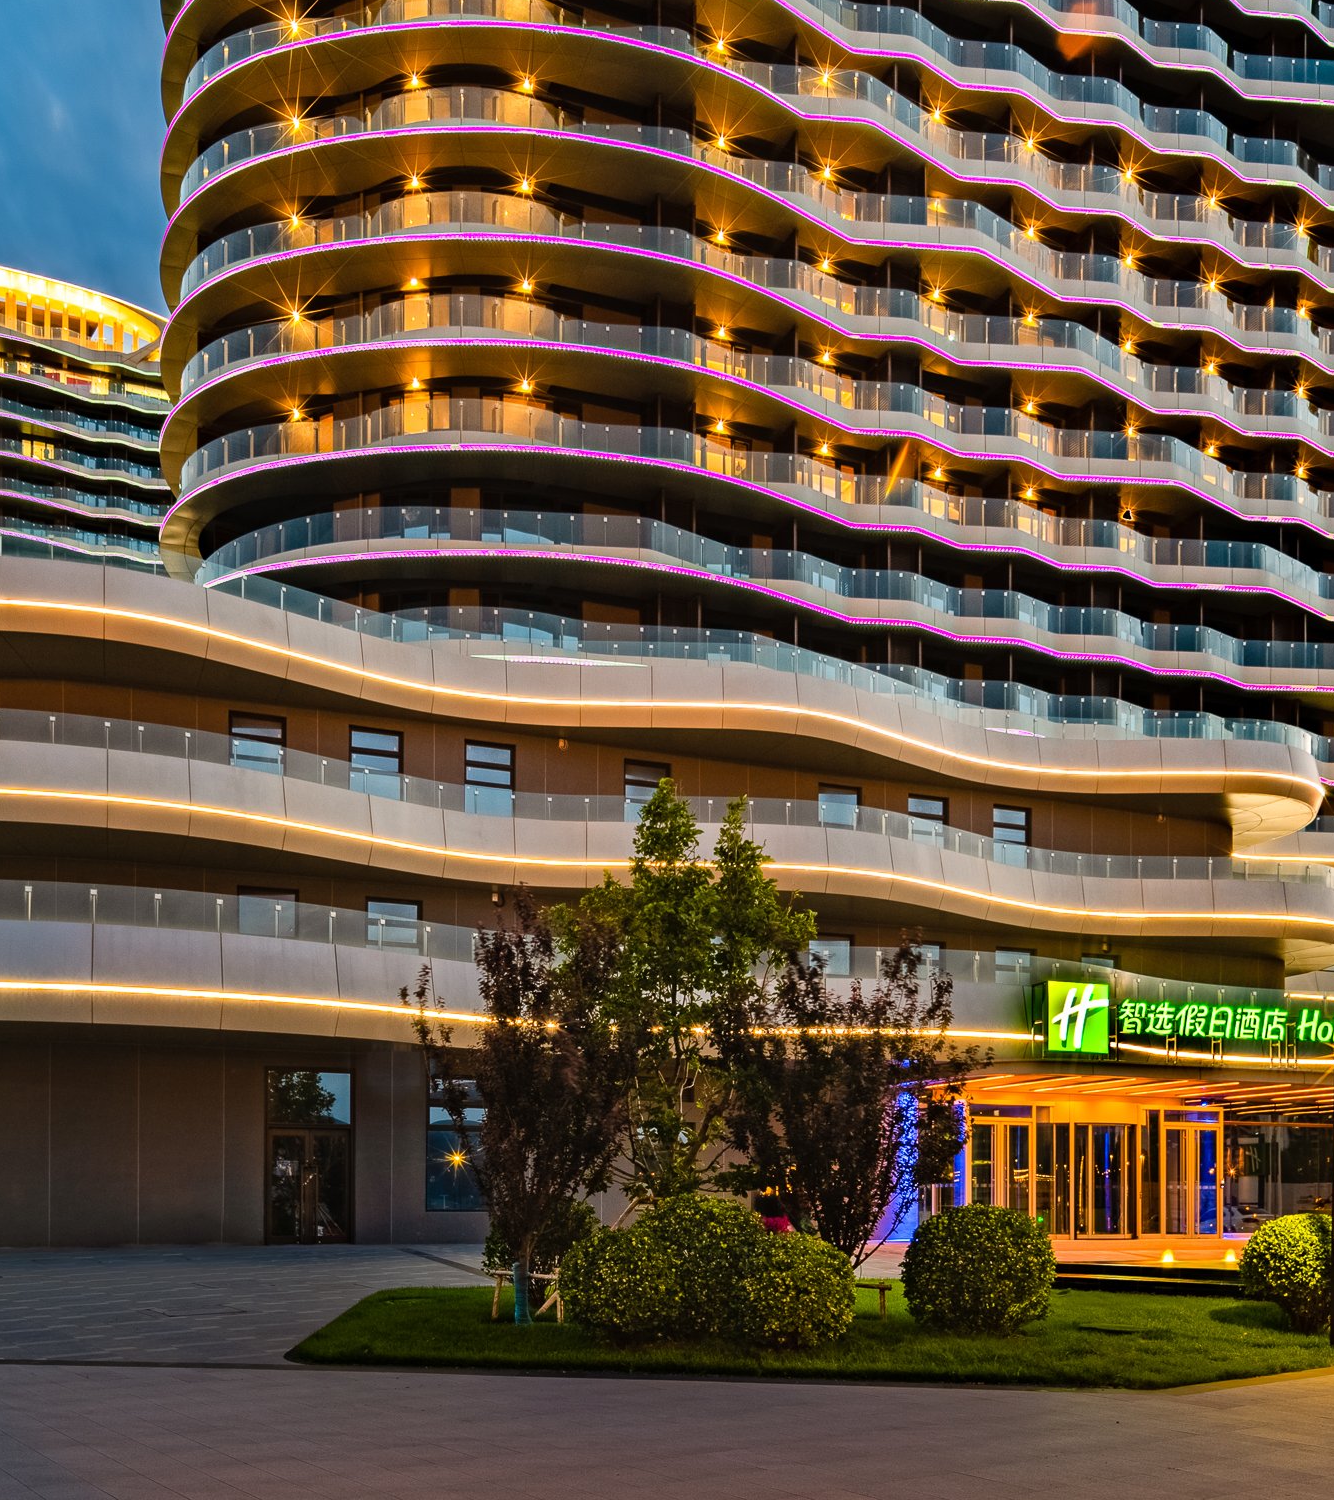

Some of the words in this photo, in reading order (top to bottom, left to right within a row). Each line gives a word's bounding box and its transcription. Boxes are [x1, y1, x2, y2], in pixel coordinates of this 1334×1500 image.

[1119, 999, 1288, 1041] 智选假日酒店
